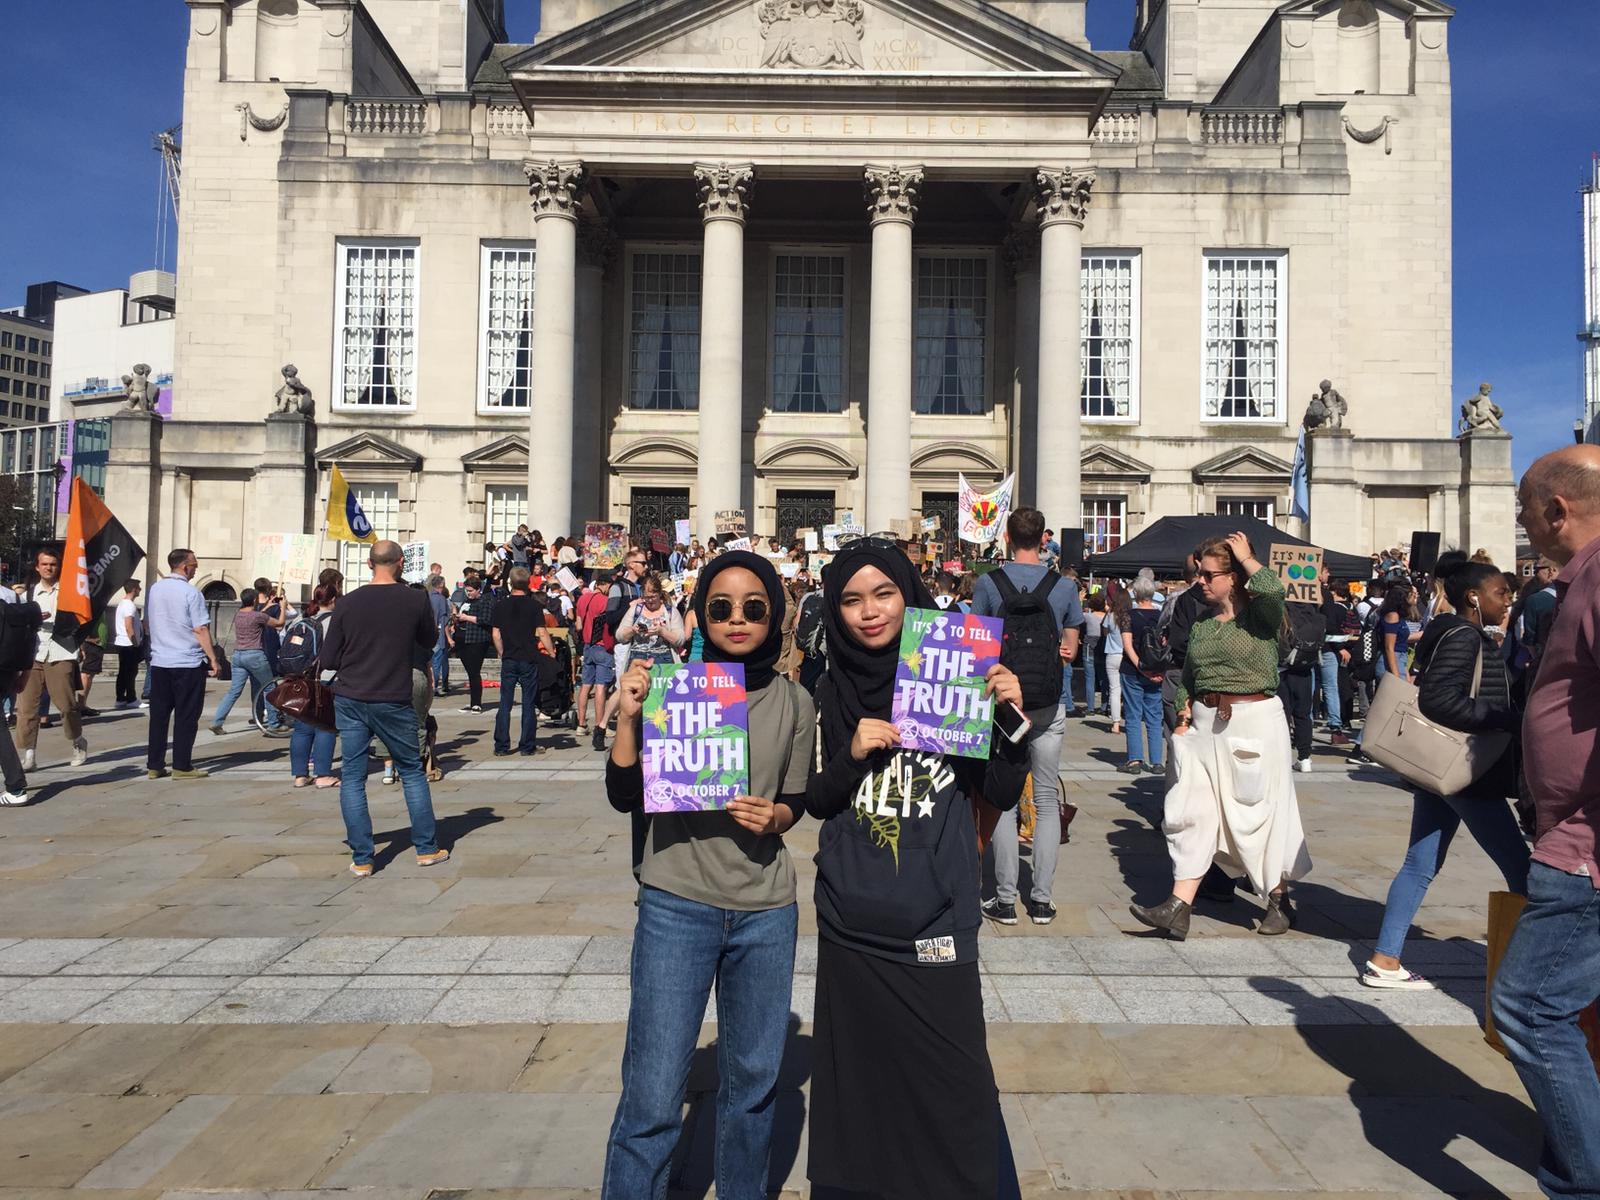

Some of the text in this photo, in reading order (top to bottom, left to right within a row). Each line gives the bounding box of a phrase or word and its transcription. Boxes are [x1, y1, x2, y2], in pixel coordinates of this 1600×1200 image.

[873, 39, 920, 53] MCM
[873, 55, 919, 70] XXXIII
[632, 112, 988, 137] PRO REGE ET LEGE
[714, 510, 745, 519] ACTION
[1272, 551, 1321, 563] IT'S NOT
[1274, 561, 1317, 581] TOO
[1286, 582, 1318, 602] ATE
[912, 621, 992, 641] IT'S TO TELL
[922, 646, 977, 684] THE
[653, 675, 736, 689] IT'S TO TELL
[898, 679, 992, 721] TRUTH
[667, 701, 723, 735] THE
[922, 726, 984, 745] OCTOBER 7
[646, 737, 745, 773] TRUTH
[677, 784, 741, 798] OCTOBER 7
[855, 764, 913, 818] ALI
